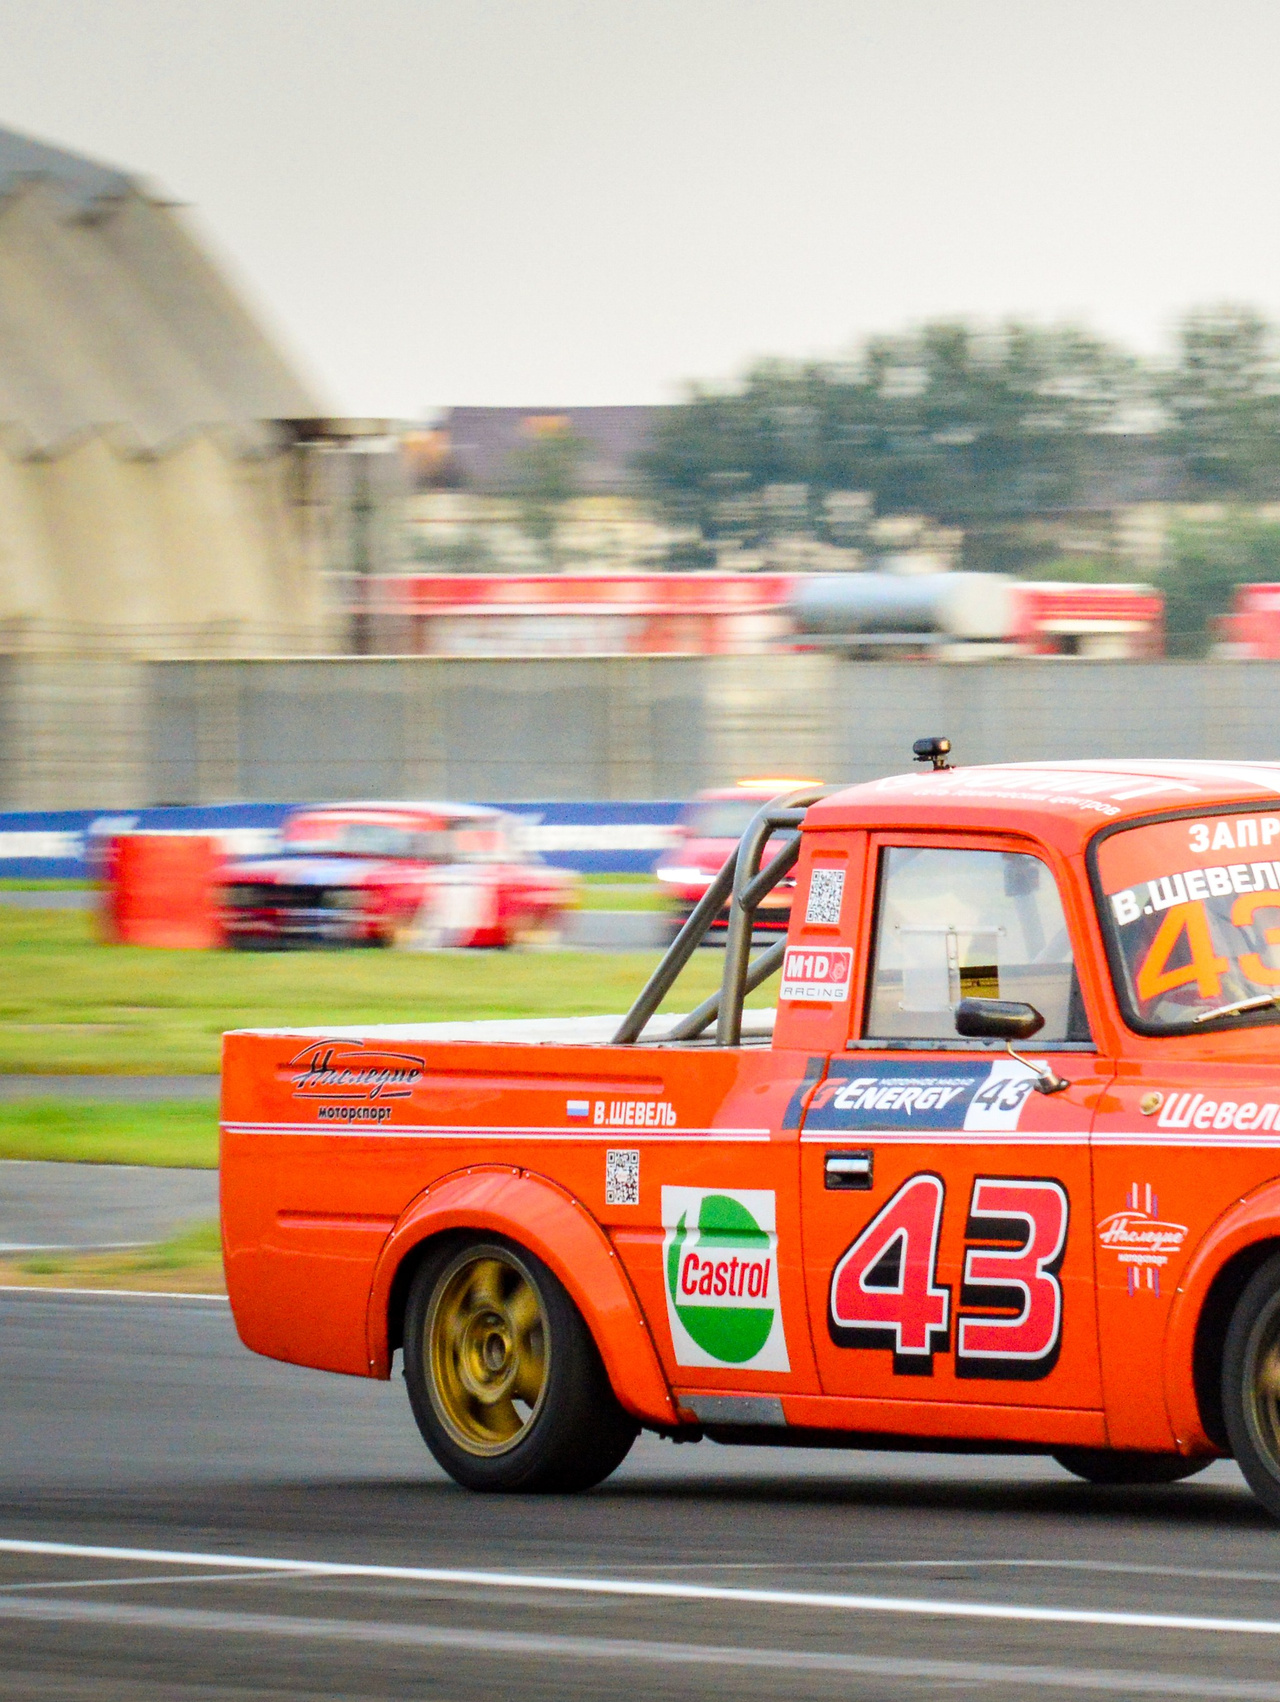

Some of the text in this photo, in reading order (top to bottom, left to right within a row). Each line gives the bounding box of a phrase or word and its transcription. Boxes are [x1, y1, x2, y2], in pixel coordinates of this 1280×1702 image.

[786, 954, 830, 979] M1D
[783, 986, 844, 998] RACING
[973, 1078, 1038, 1113] 43
[318, 1106, 392, 1125] моторспорт
[593, 1101, 678, 1127] В.ШЕВЕЛЬ
[681, 1252, 771, 1299] Castrol
[831, 1172, 1069, 1378] 43
